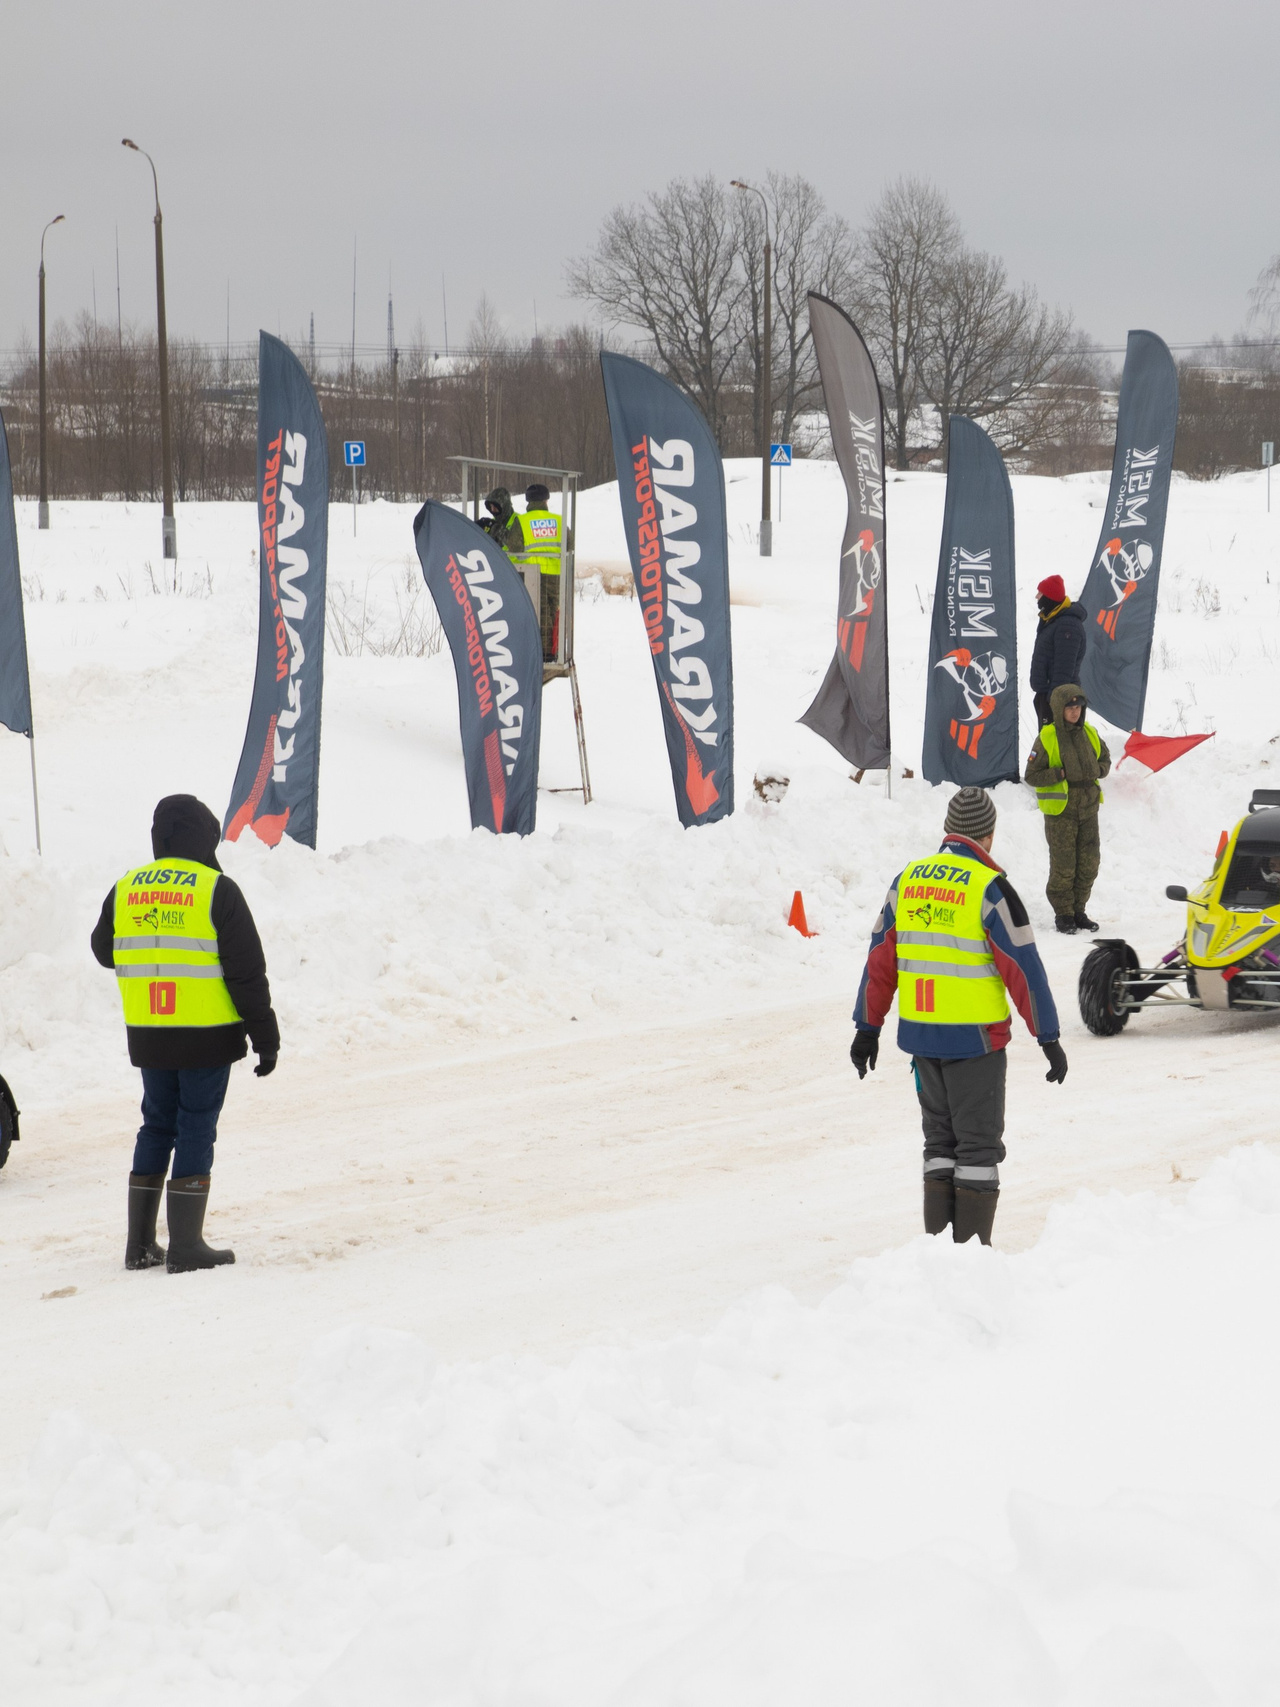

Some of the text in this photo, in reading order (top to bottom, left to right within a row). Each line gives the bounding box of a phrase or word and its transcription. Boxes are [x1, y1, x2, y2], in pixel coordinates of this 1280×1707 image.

[350, 444, 362, 463] P
[531, 519, 556, 529] LIQUI
[533, 528, 557, 538] MOLY
[131, 869, 198, 887] RUSTA
[909, 864, 972, 885] RUSTA
[127, 891, 194, 907] МАРШАЛ
[903, 886, 966, 906] МАРШАЛ
[161, 910, 185, 925] MSK
[933, 906, 956, 923] MSK
[149, 981, 177, 1016] 10
[916, 978, 935, 1013] 11
